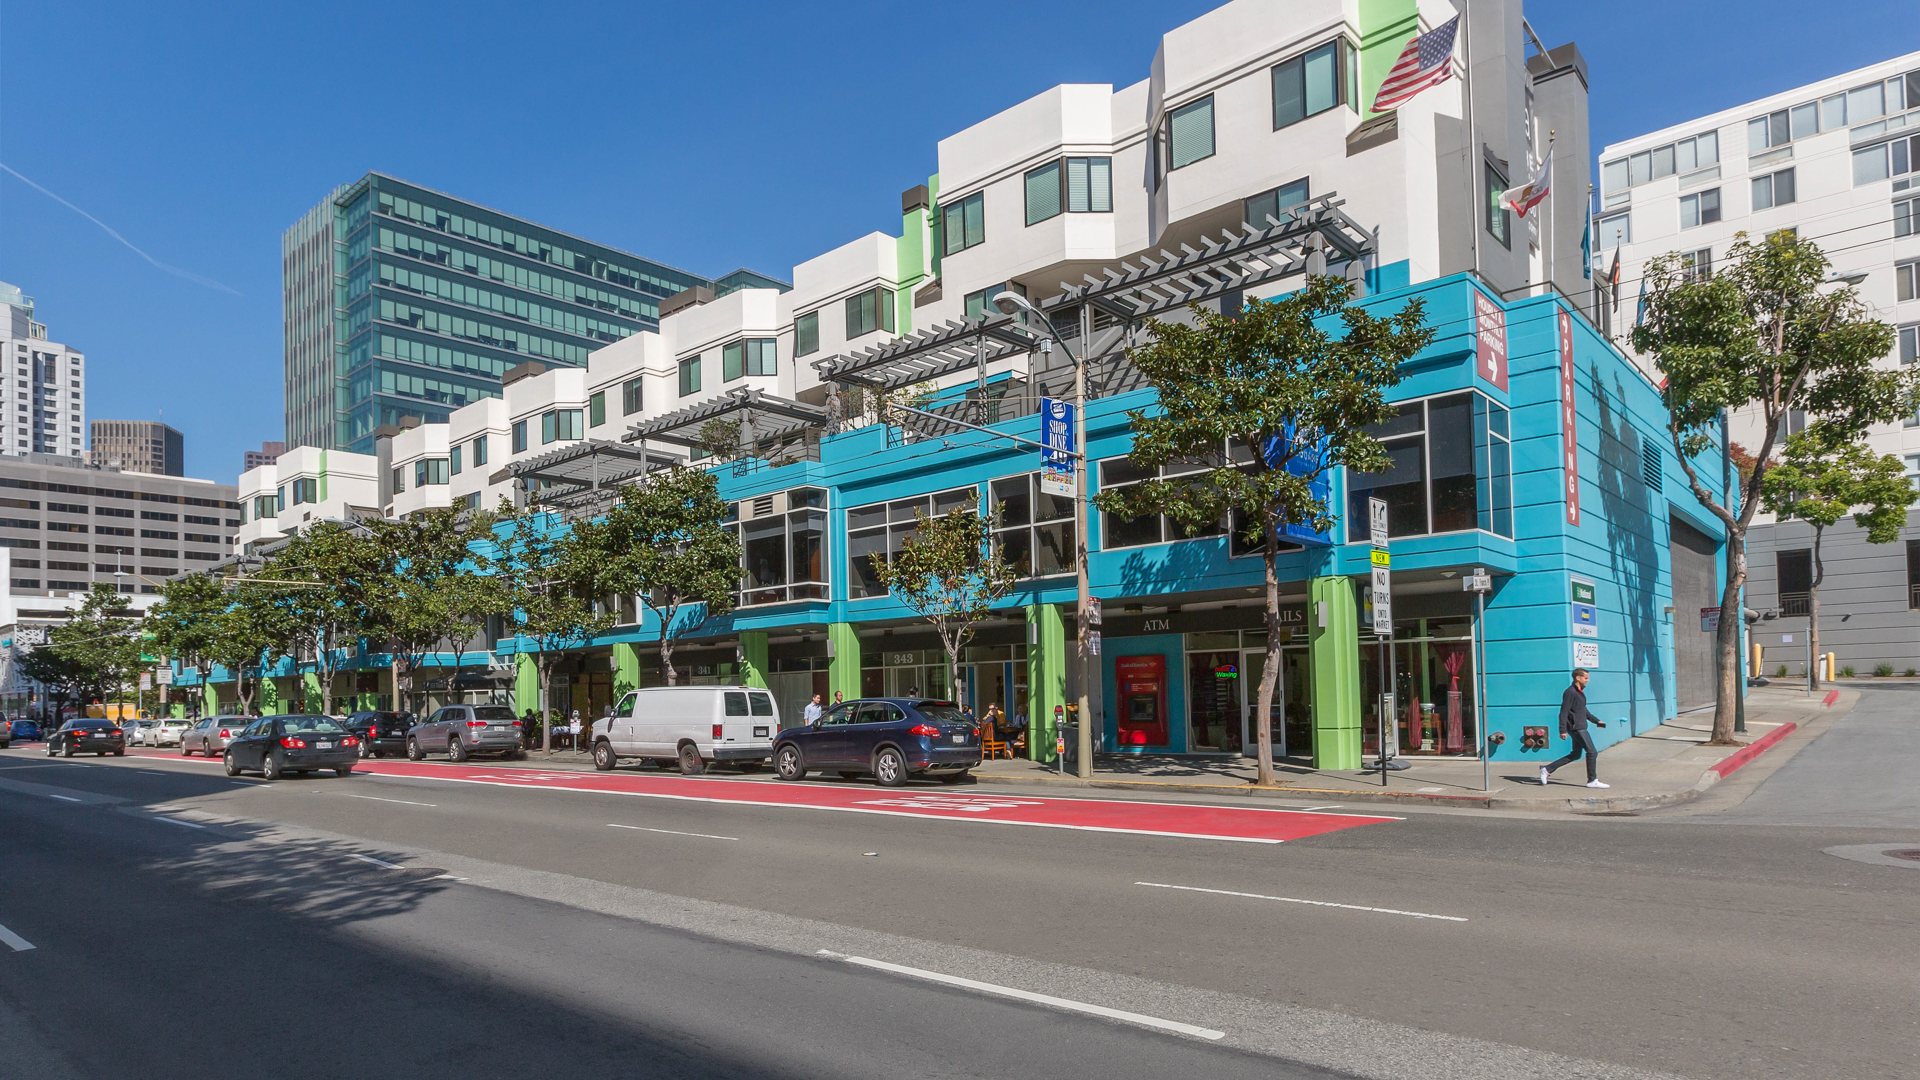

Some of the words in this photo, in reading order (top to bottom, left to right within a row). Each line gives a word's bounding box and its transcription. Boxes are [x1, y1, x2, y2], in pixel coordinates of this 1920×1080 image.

[1477, 295, 1498, 321] HOURLY
[1498, 311, 1503, 325] &
[1478, 311, 1503, 339] MONTHLY
[1479, 326, 1504, 356] PARKING
[1563, 341, 1575, 494] PARKING
[1049, 419, 1067, 436] SHOP
[1049, 432, 1067, 451] DINE
[1375, 553, 1385, 563] NEW
[1376, 571, 1386, 586] NO
[1374, 591, 1389, 605] TURNS
[1262, 610, 1302, 624] NILS
[1377, 609, 1387, 618] ONTO
[1143, 619, 1170, 631] ATM
[1375, 619, 1390, 629] MARKET
[893, 653, 914, 664] 343
[697, 665, 711, 675] 341
[1216, 671, 1238, 679] Waxing
